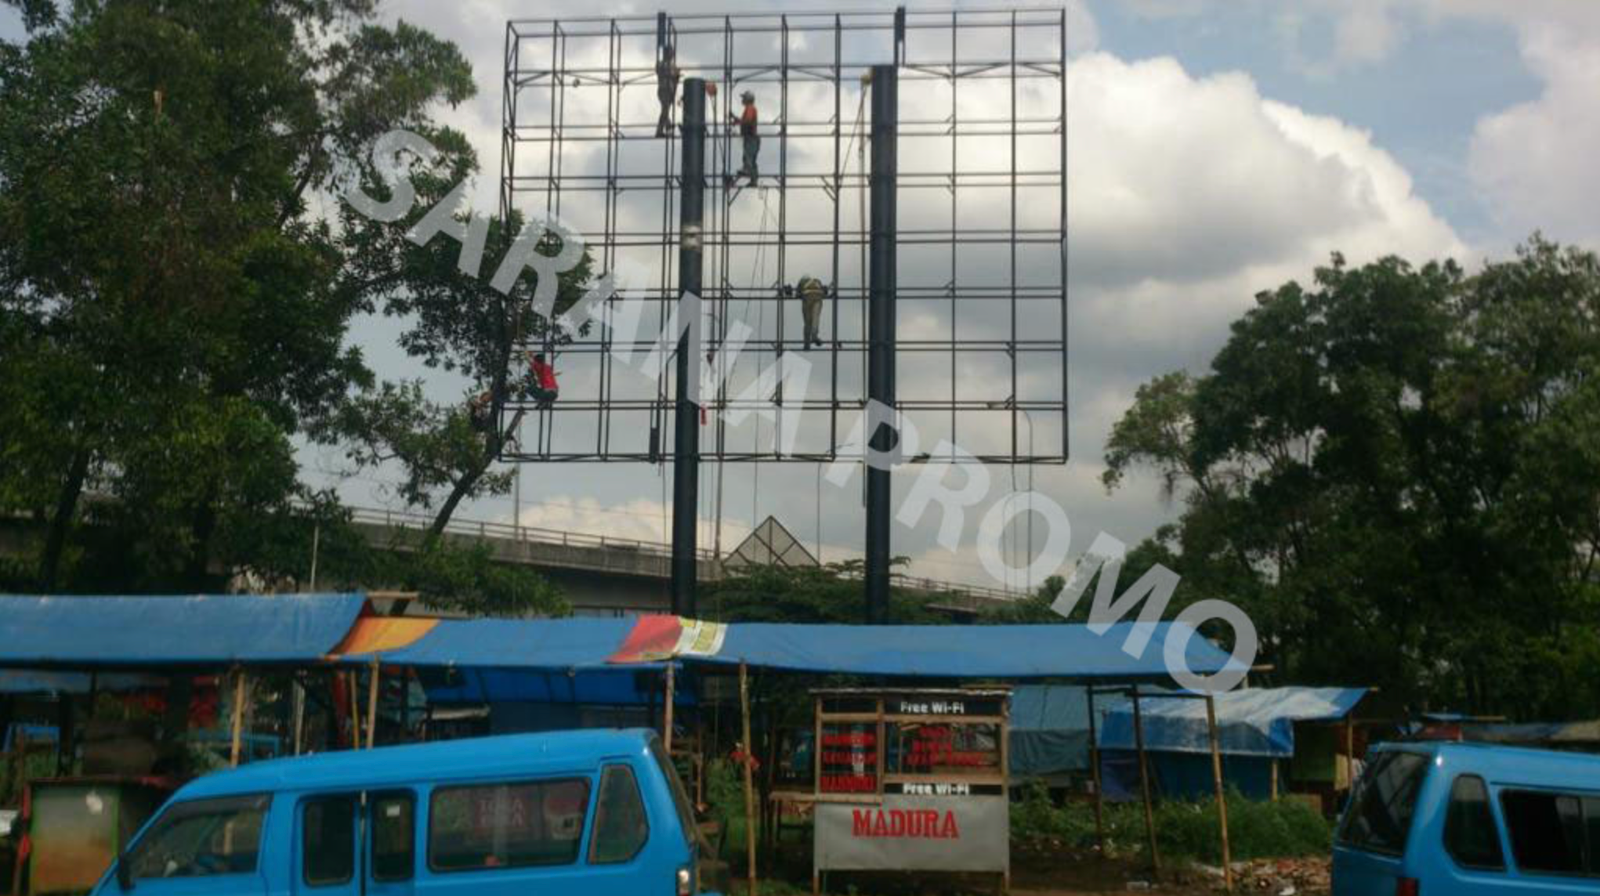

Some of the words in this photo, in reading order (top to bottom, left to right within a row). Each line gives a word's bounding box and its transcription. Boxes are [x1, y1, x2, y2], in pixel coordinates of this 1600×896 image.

[900, 702, 928, 713] Free
[932, 702, 965, 713] Wi-Fi
[903, 783, 933, 794] Free
[936, 783, 970, 794] Wi-Fi
[853, 809, 960, 838] MADURA
